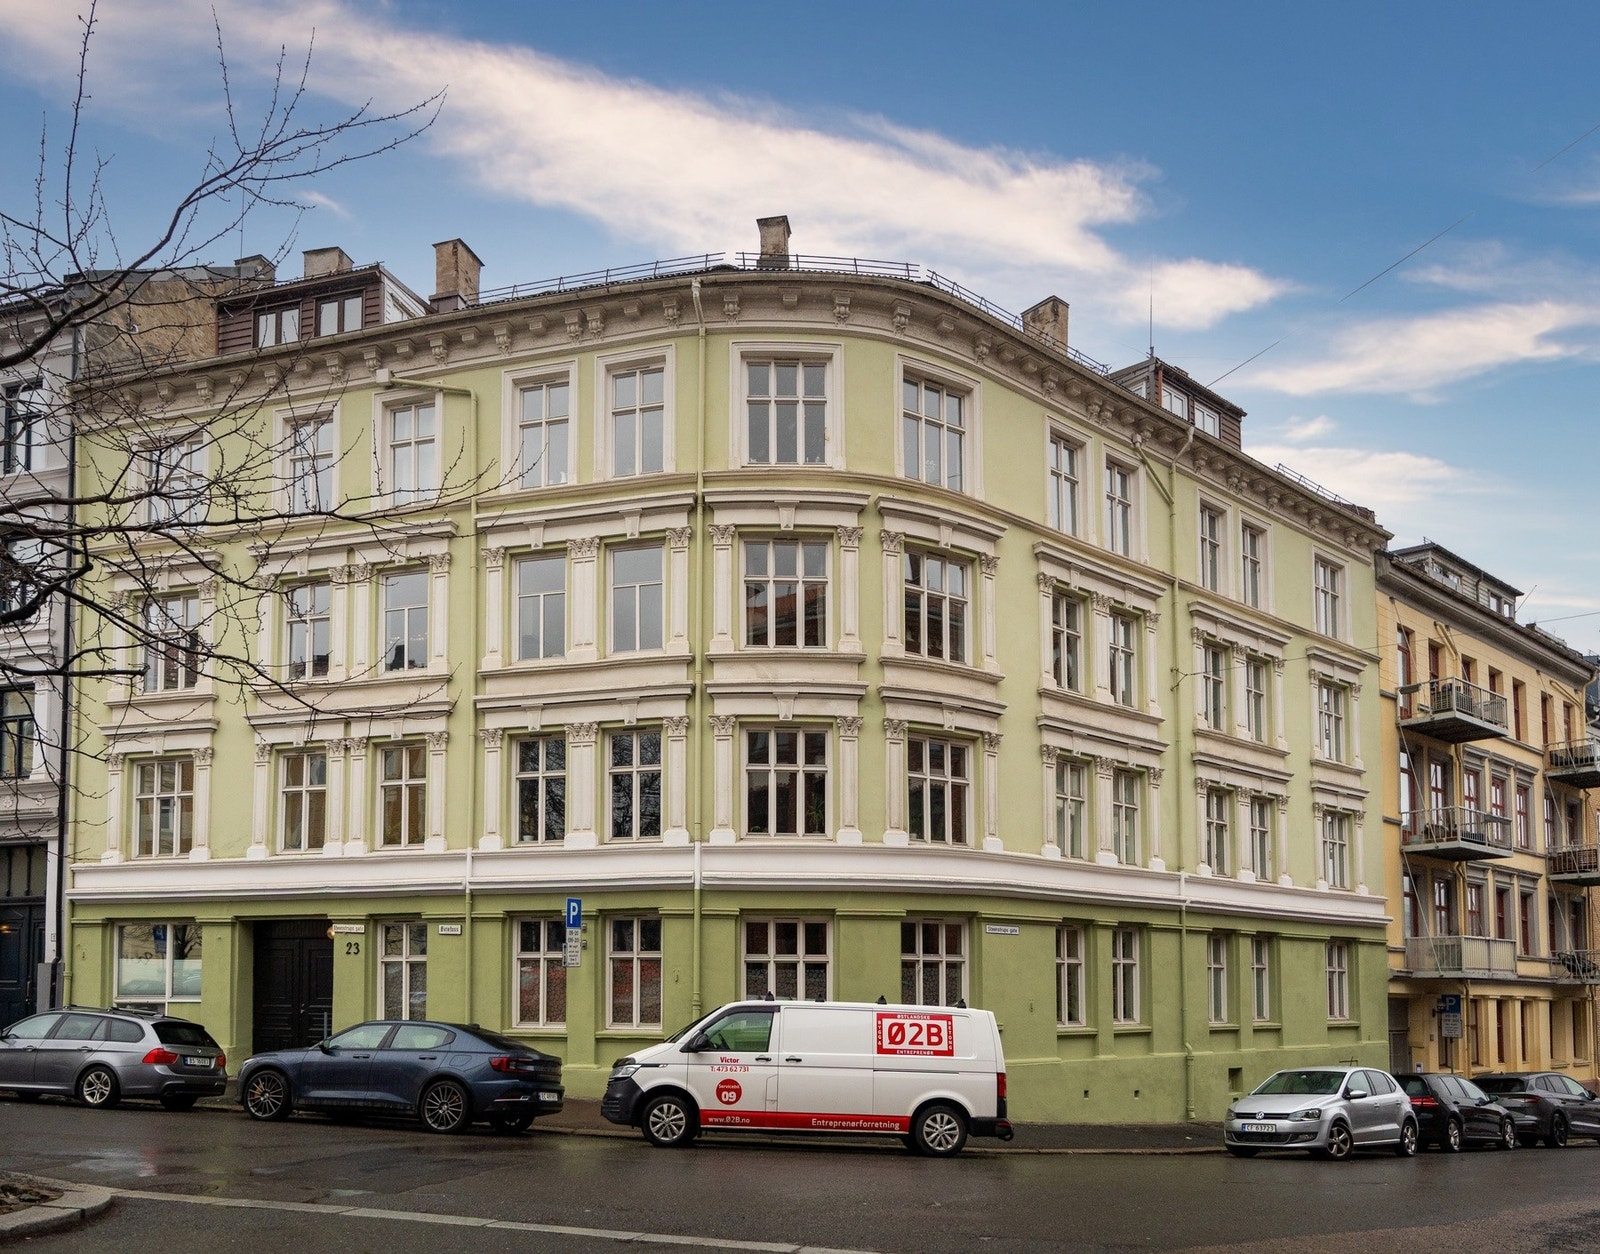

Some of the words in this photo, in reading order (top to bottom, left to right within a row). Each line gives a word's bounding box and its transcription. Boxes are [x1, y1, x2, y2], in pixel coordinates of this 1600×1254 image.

[570, 902, 578, 924] P
[346, 942, 360, 955] 23
[888, 1022, 943, 1046] Ø2B
[721, 1091, 737, 1102] 09
[708, 1116, 750, 1124] www.Ø2B.no
[811, 1118, 900, 1130] Entreprenørforretning
